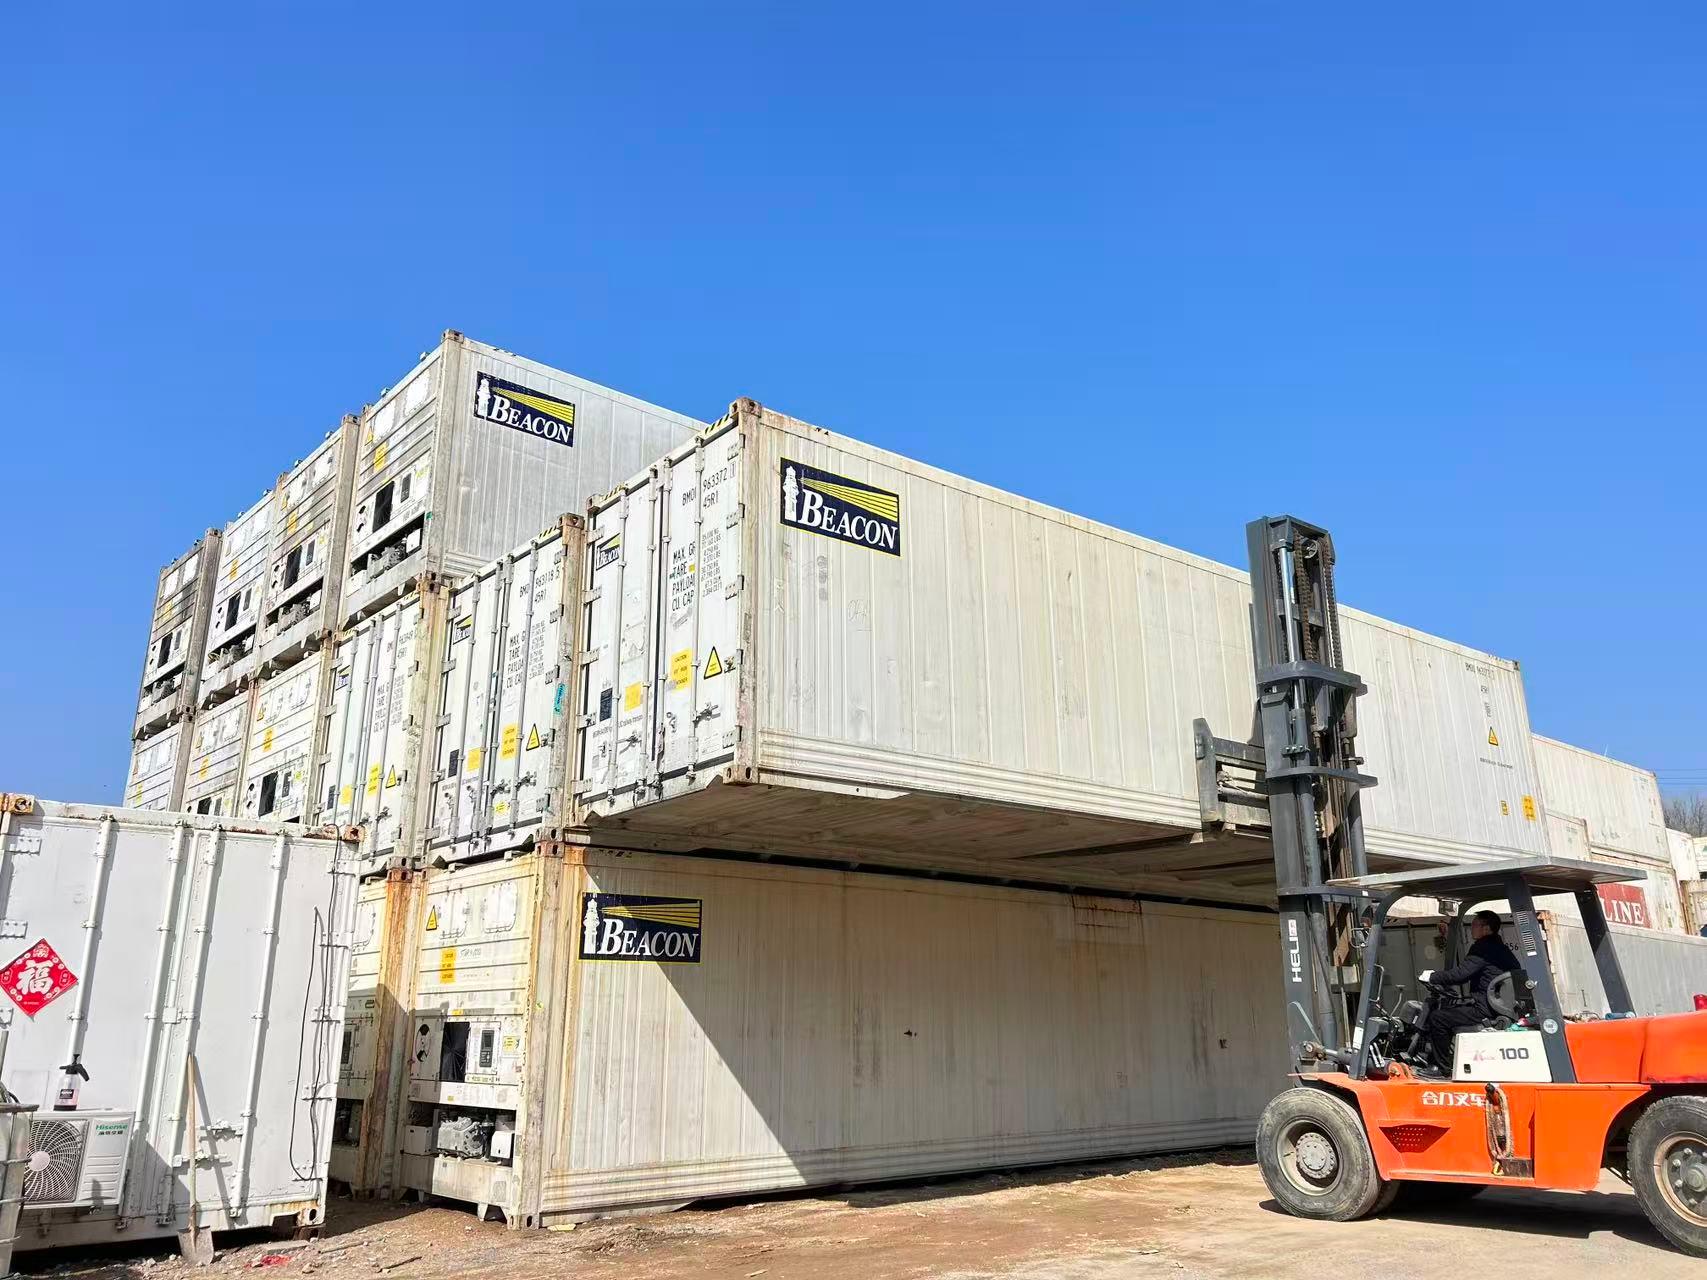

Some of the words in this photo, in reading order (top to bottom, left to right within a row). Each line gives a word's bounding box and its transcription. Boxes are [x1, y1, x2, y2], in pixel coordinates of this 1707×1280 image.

[487, 395, 573, 443] BEACON
[702, 468, 727, 491] 963372
[702, 491, 719, 509] 45R1
[797, 488, 899, 549] BEACON
[673, 561, 688, 579] TARE
[1600, 898, 1645, 925] LINE
[596, 918, 699, 957] BEACON
[16, 960, 54, 995] 福
[1499, 1048, 1530, 1060] 100
